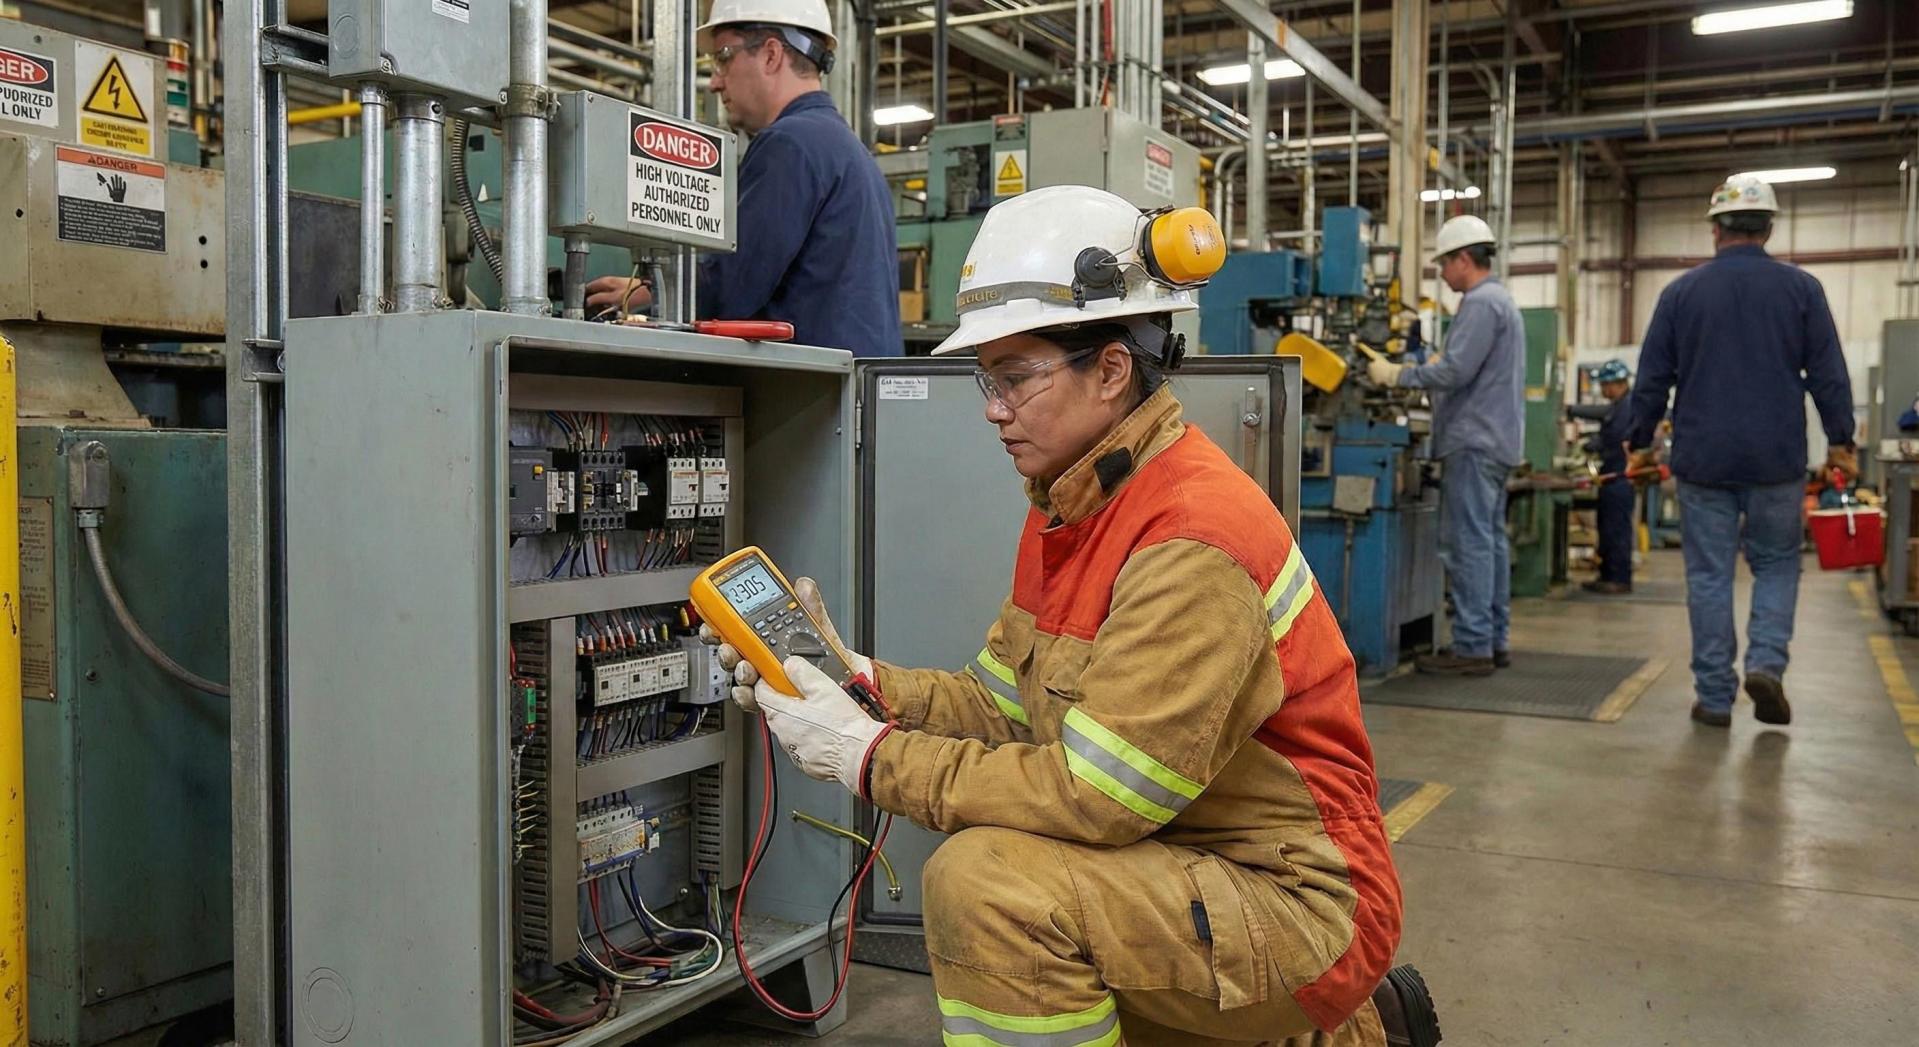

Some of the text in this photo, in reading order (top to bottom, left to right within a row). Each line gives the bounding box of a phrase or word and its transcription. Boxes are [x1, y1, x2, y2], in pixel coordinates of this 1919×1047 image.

[12, 104, 42, 120] ONLY
[643, 127, 711, 164] DANGER
[97, 157, 138, 171] DANGER
[636, 162, 662, 183] HIGH
[665, 169, 710, 193] VOLTAGE
[631, 202, 721, 233] PERSONNEL ONLY
